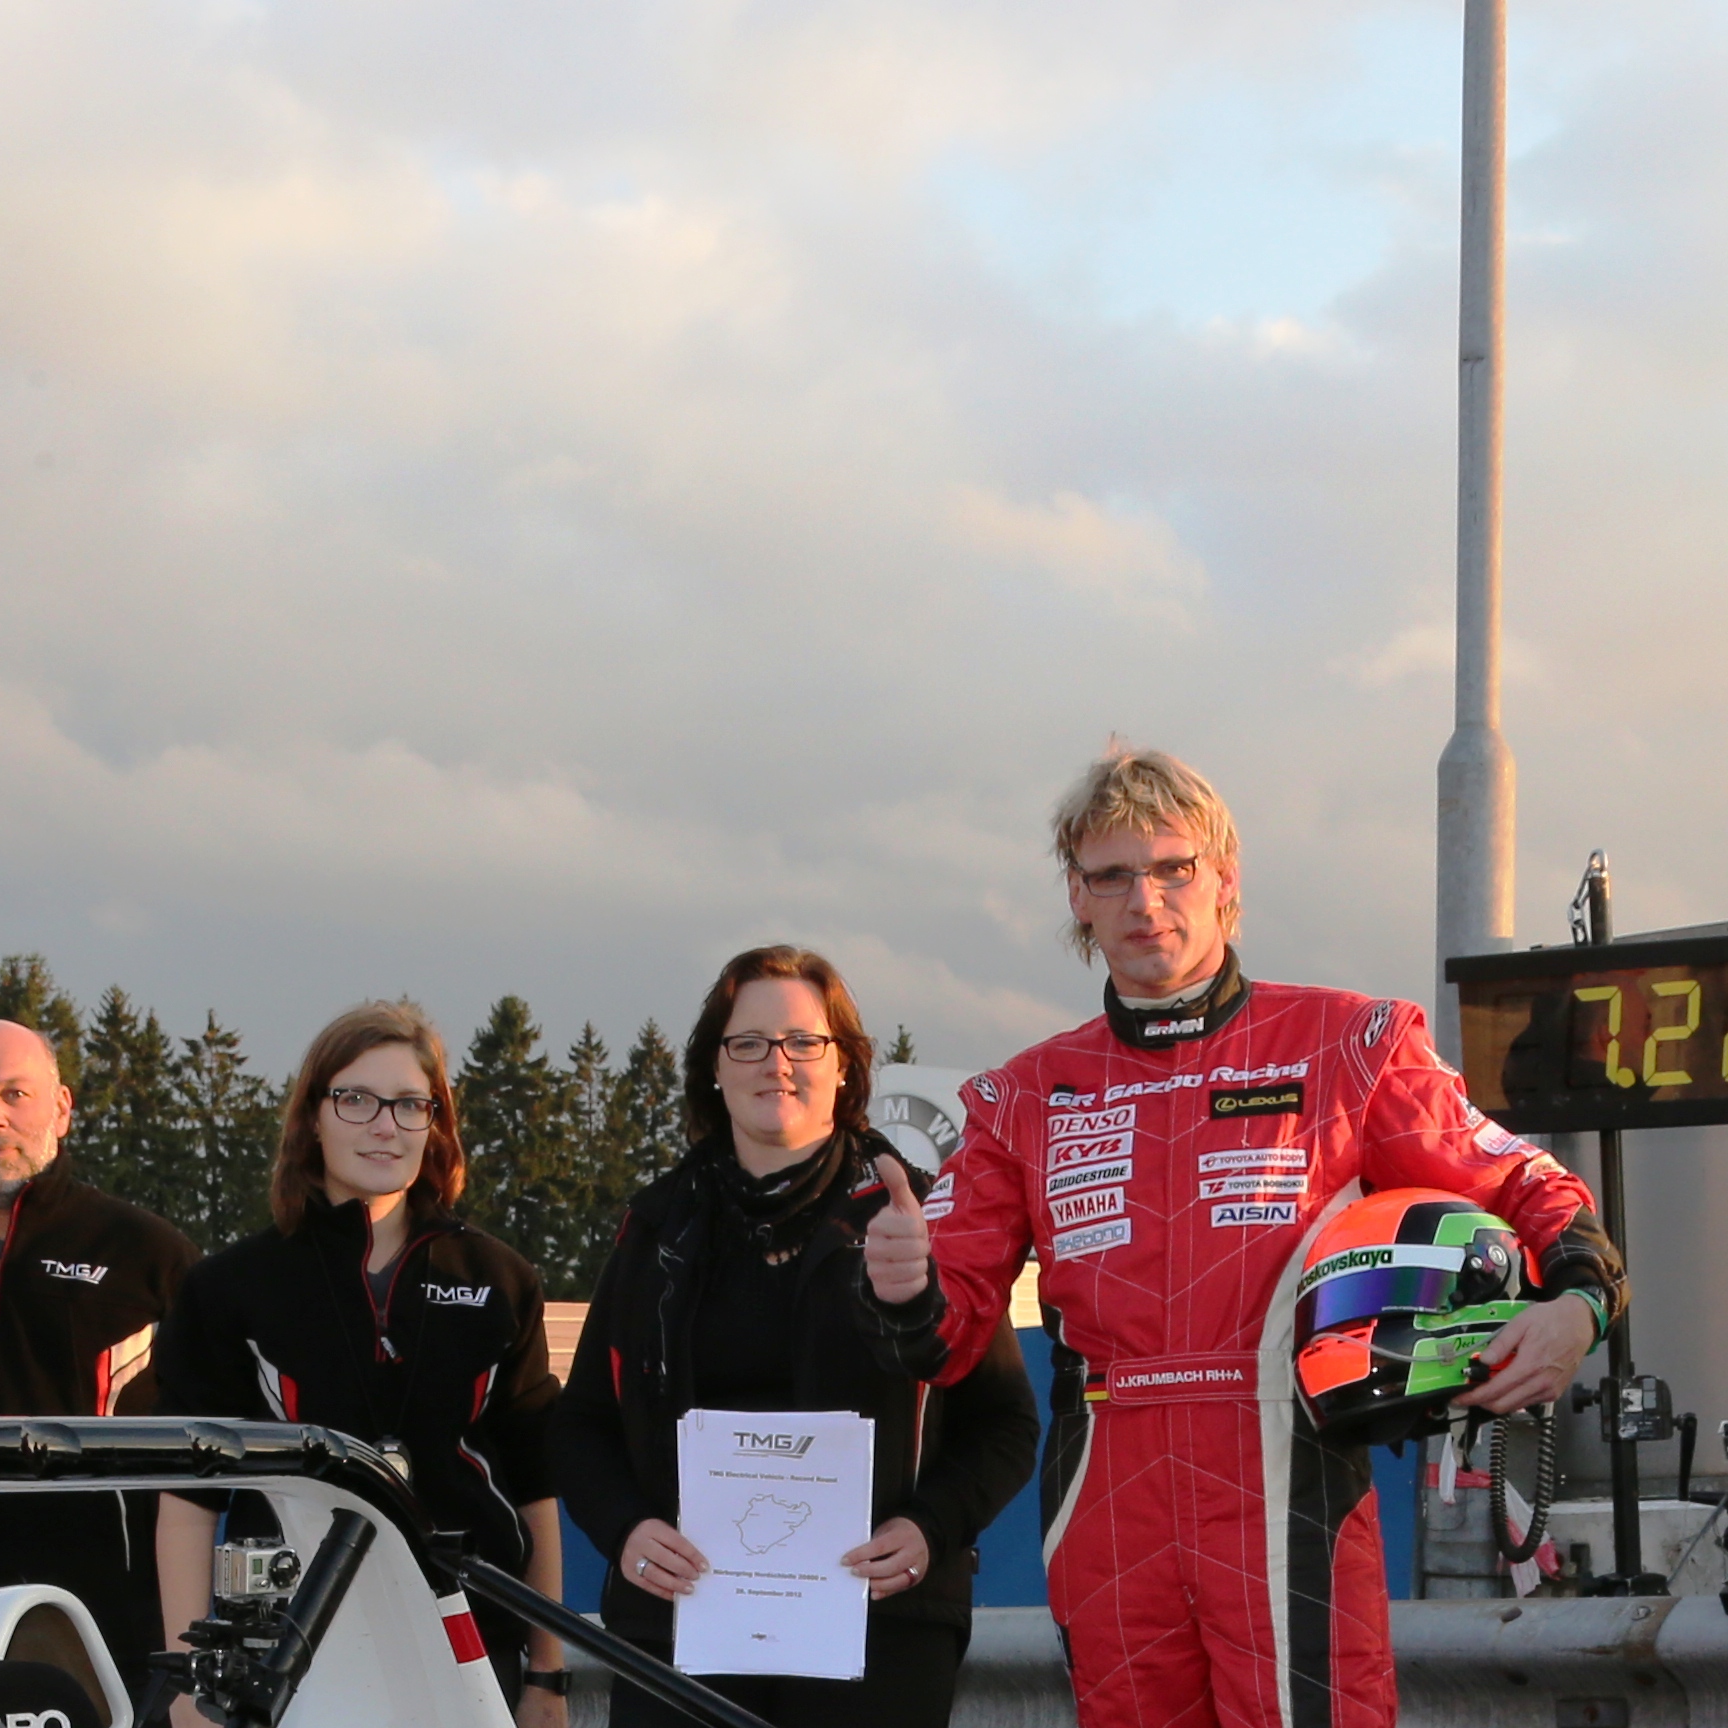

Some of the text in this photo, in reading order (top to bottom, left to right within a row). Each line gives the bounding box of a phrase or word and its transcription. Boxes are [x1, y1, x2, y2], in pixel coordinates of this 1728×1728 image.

[1048, 1061, 1309, 1108] GR GAZOO Racing
[1238, 1092, 1299, 1107] LEXUS
[883, 1097, 957, 1147] MW
[1050, 1109, 1130, 1136] DENSO
[1055, 1138, 1122, 1165] KYB
[1220, 1153, 1304, 1164] TOYOTA AUTO BODY
[1049, 1165, 1129, 1192] BRIDGESTONE
[1229, 1180, 1261, 1190] TOYOTA
[1055, 1193, 1118, 1223] YAMAHA
[1215, 1205, 1292, 1223] AISIN
[1055, 1225, 1125, 1253] akebono
[40, 1259, 92, 1277] TMG
[420, 1283, 474, 1302] TMG
[1115, 1368, 1244, 1389] J.KRUMBACH RH+A
[733, 1431, 793, 1450] TMG
